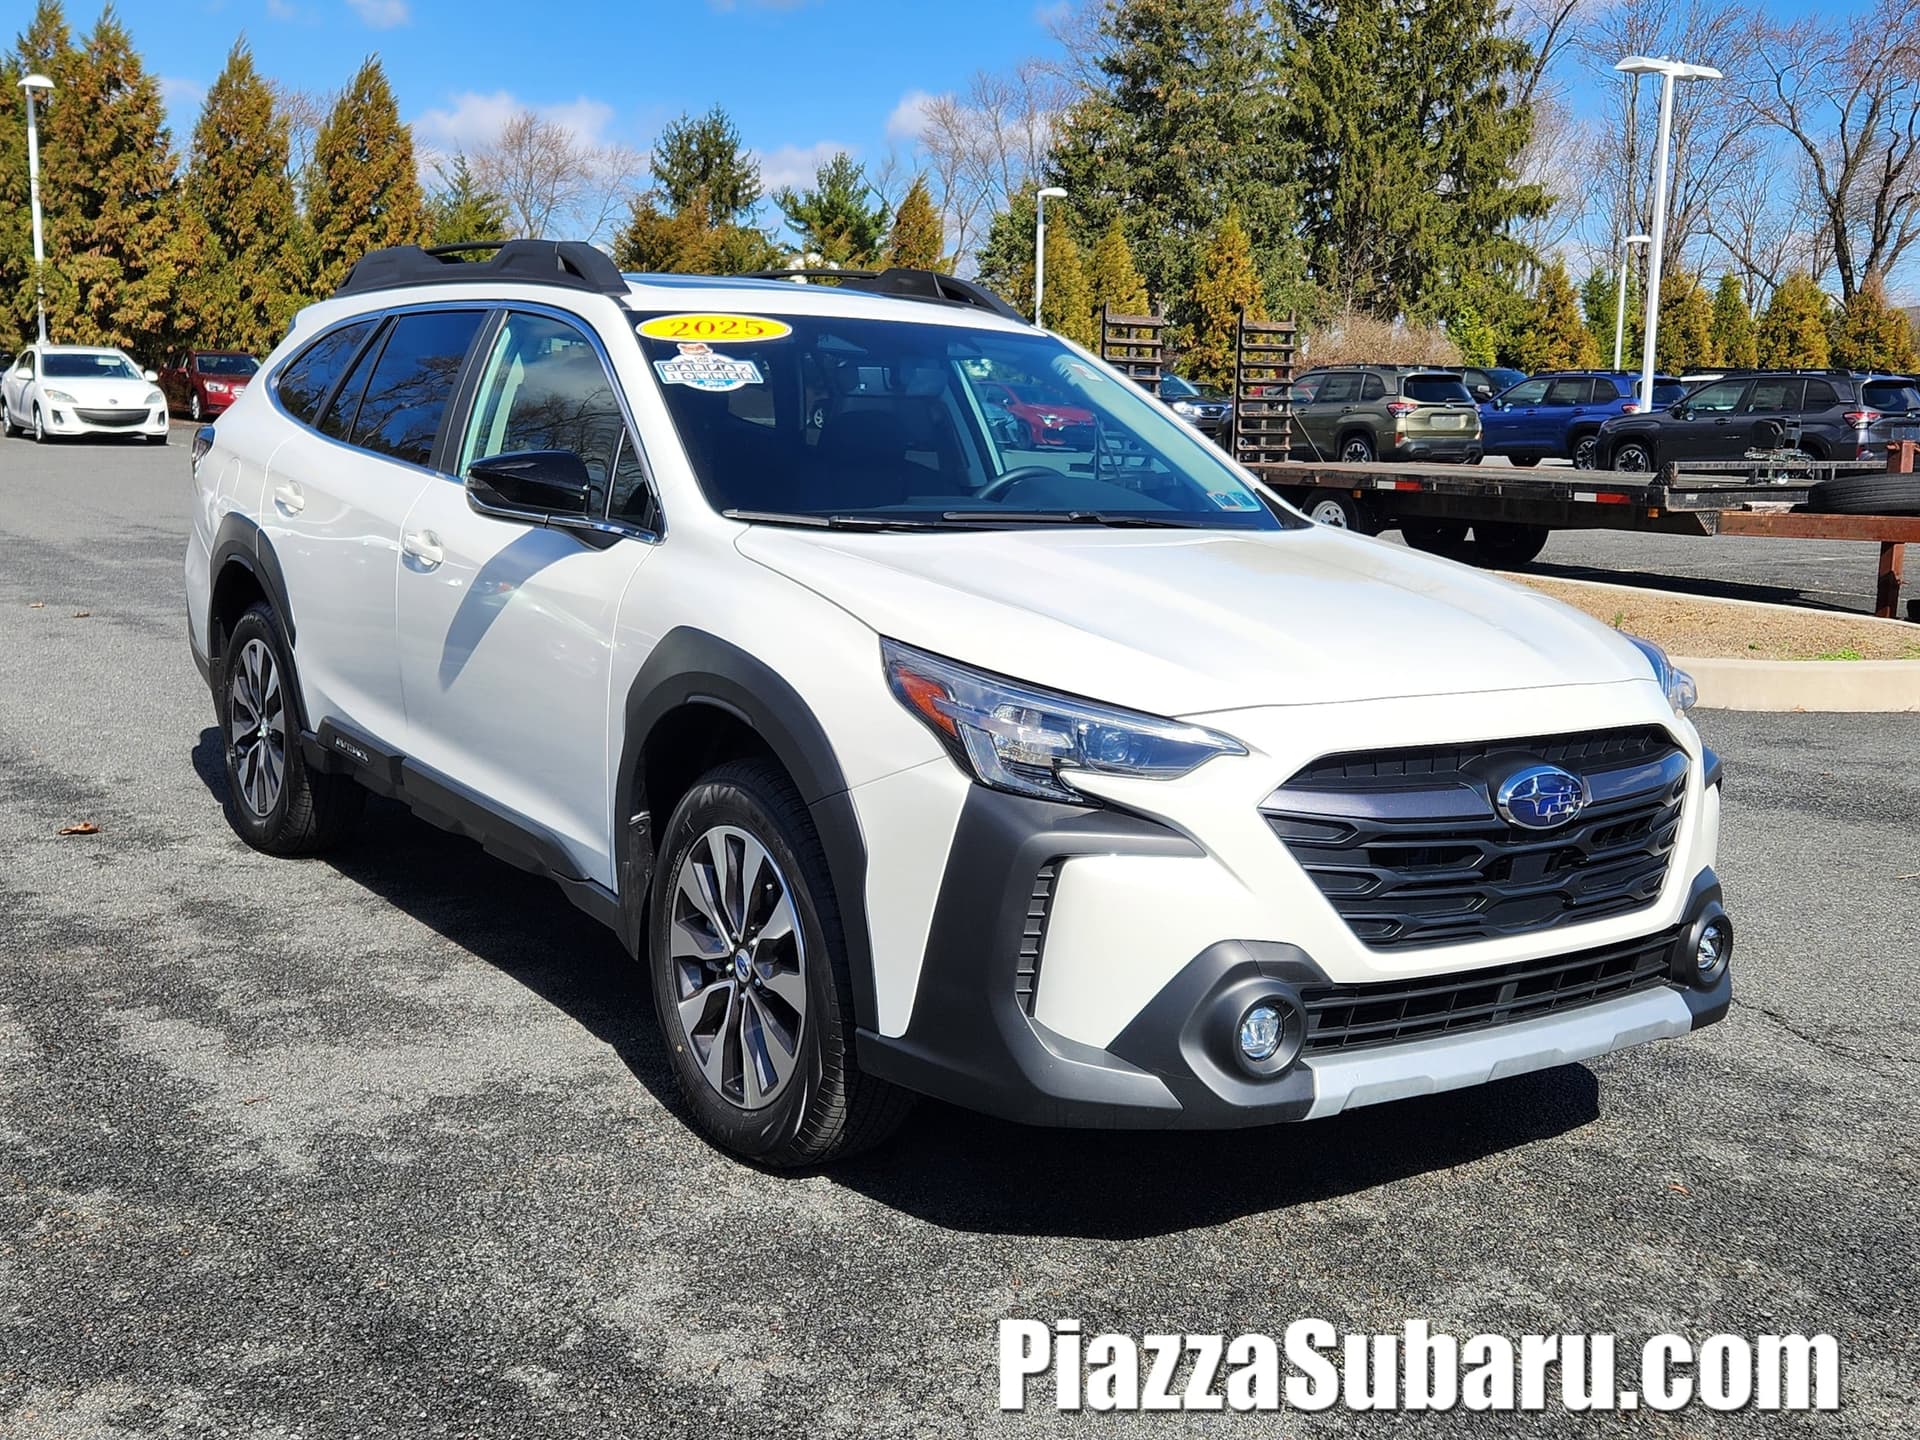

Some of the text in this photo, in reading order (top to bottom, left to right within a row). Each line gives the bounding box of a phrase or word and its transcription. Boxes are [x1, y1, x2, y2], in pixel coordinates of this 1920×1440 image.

[670, 320, 765, 337] 2025
[663, 363, 750, 372] CARFAX
[681, 372, 755, 380] OWNER
